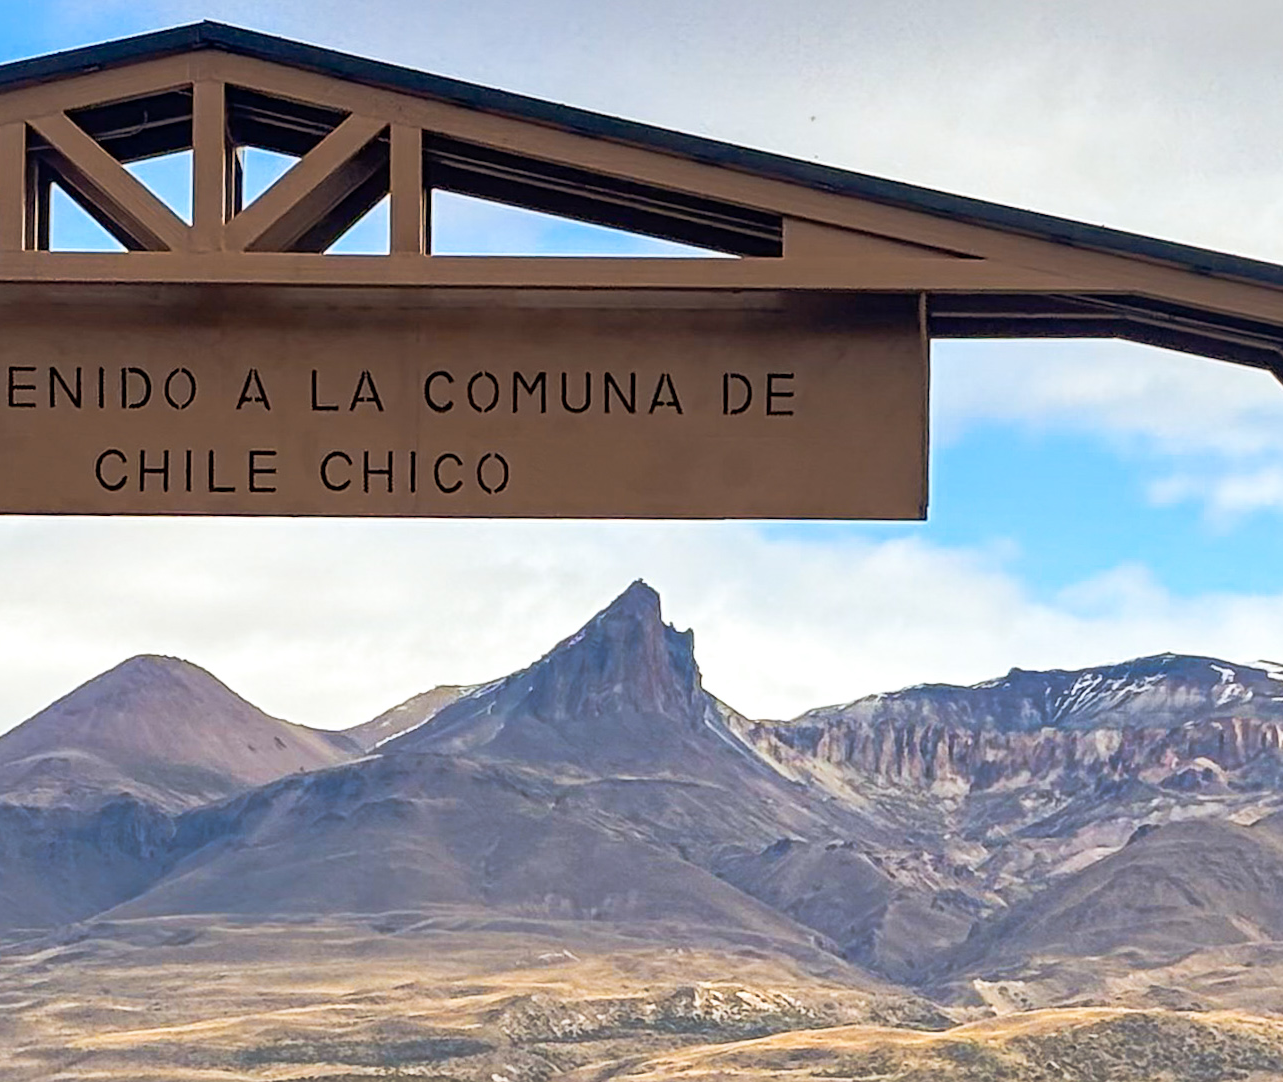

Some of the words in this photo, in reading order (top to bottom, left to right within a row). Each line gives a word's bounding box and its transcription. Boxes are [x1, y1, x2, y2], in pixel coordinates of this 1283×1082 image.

[235, 368, 272, 412] A
[311, 369, 385, 413] LA
[423, 370, 684, 415] COMUNA
[722, 372, 795, 417] DE
[95, 448, 278, 493] CHILE
[319, 450, 510, 495] CHICO
